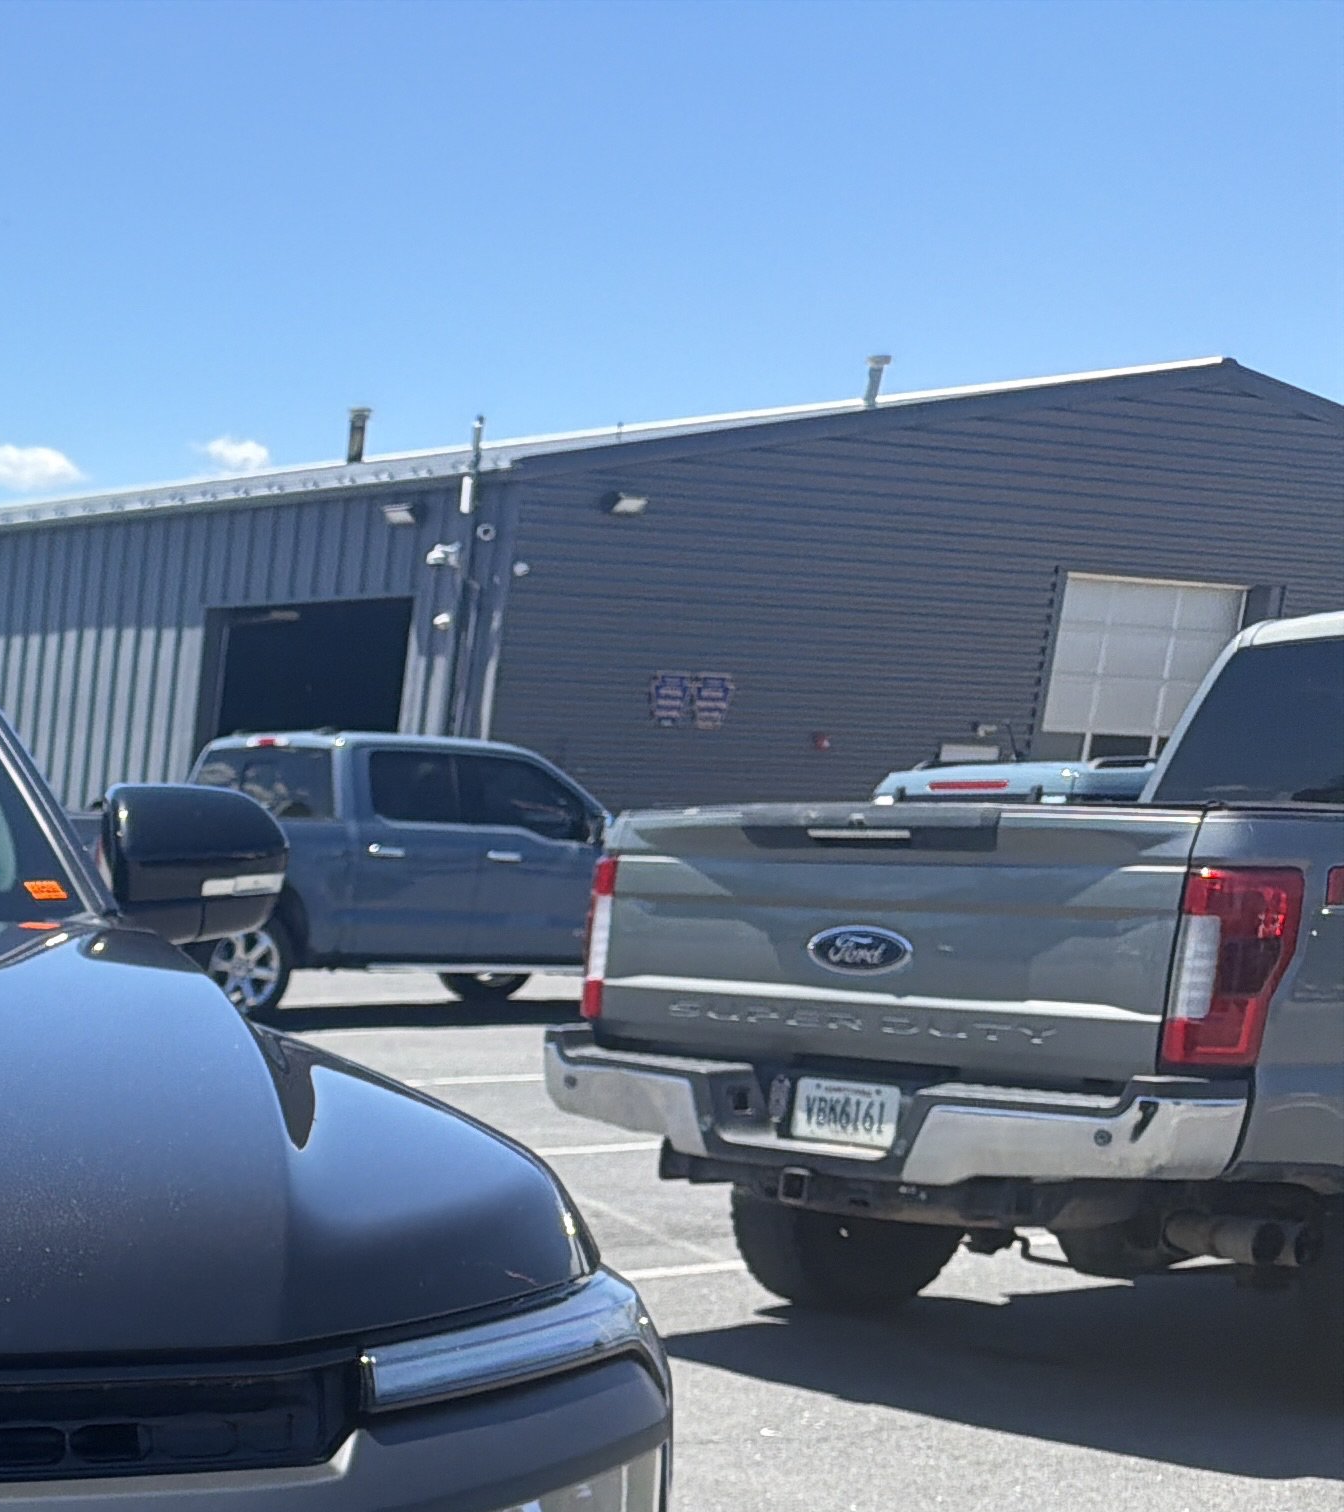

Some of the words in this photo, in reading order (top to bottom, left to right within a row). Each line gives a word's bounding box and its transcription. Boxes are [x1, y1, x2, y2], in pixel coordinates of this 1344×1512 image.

[828, 934, 886, 964] Ford
[668, 1002, 863, 1032] SUPER
[880, 1014, 1058, 1046] DUTY
